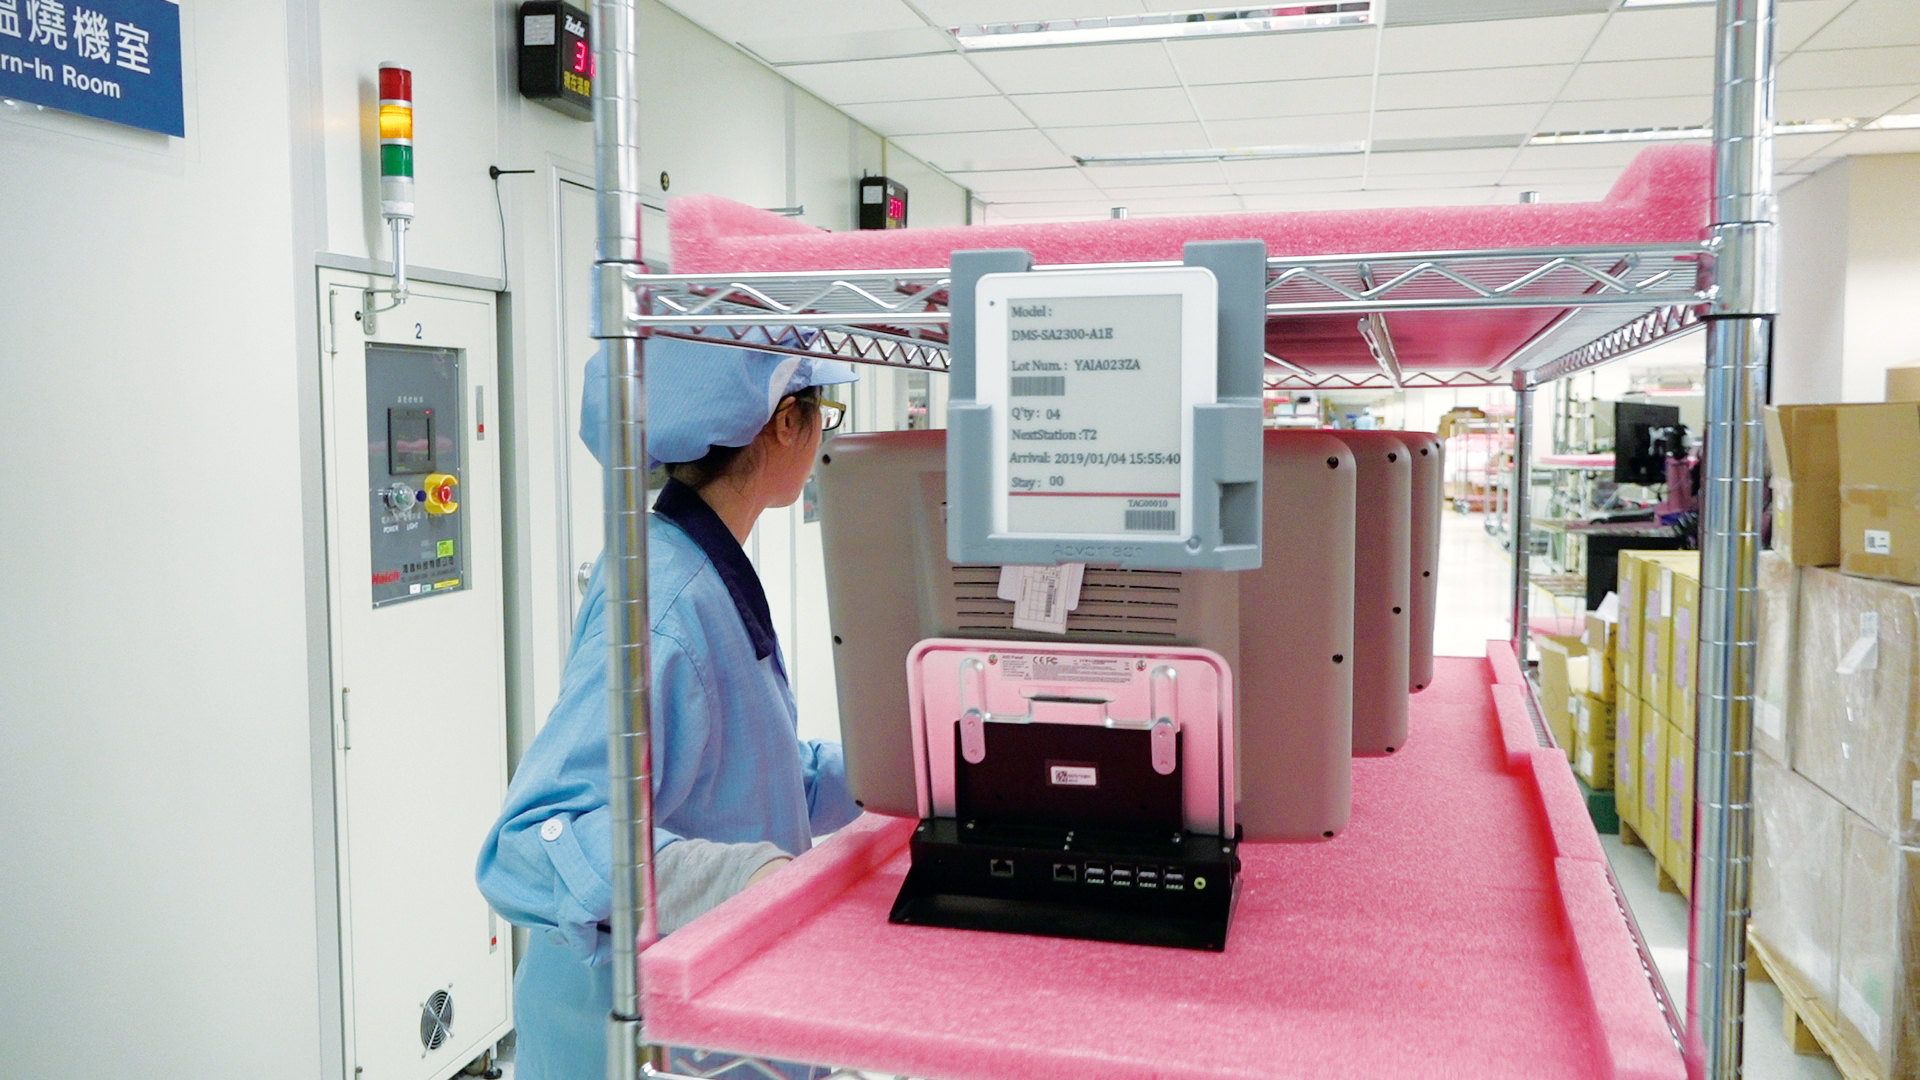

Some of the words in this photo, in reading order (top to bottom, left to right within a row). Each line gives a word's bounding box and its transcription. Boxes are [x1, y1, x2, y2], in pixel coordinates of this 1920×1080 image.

[62, 64, 121, 99] Room
[415, 322, 423, 340] 2
[1011, 327, 1114, 341] DMS-SA2300-A1E
[1011, 360, 1029, 372] Lot
[1046, 408, 1061, 420] 04
[1054, 453, 1126, 467] 2019/01/04
[1129, 453, 1181, 465] 15:55:40
[1049, 476, 1064, 486] 00
